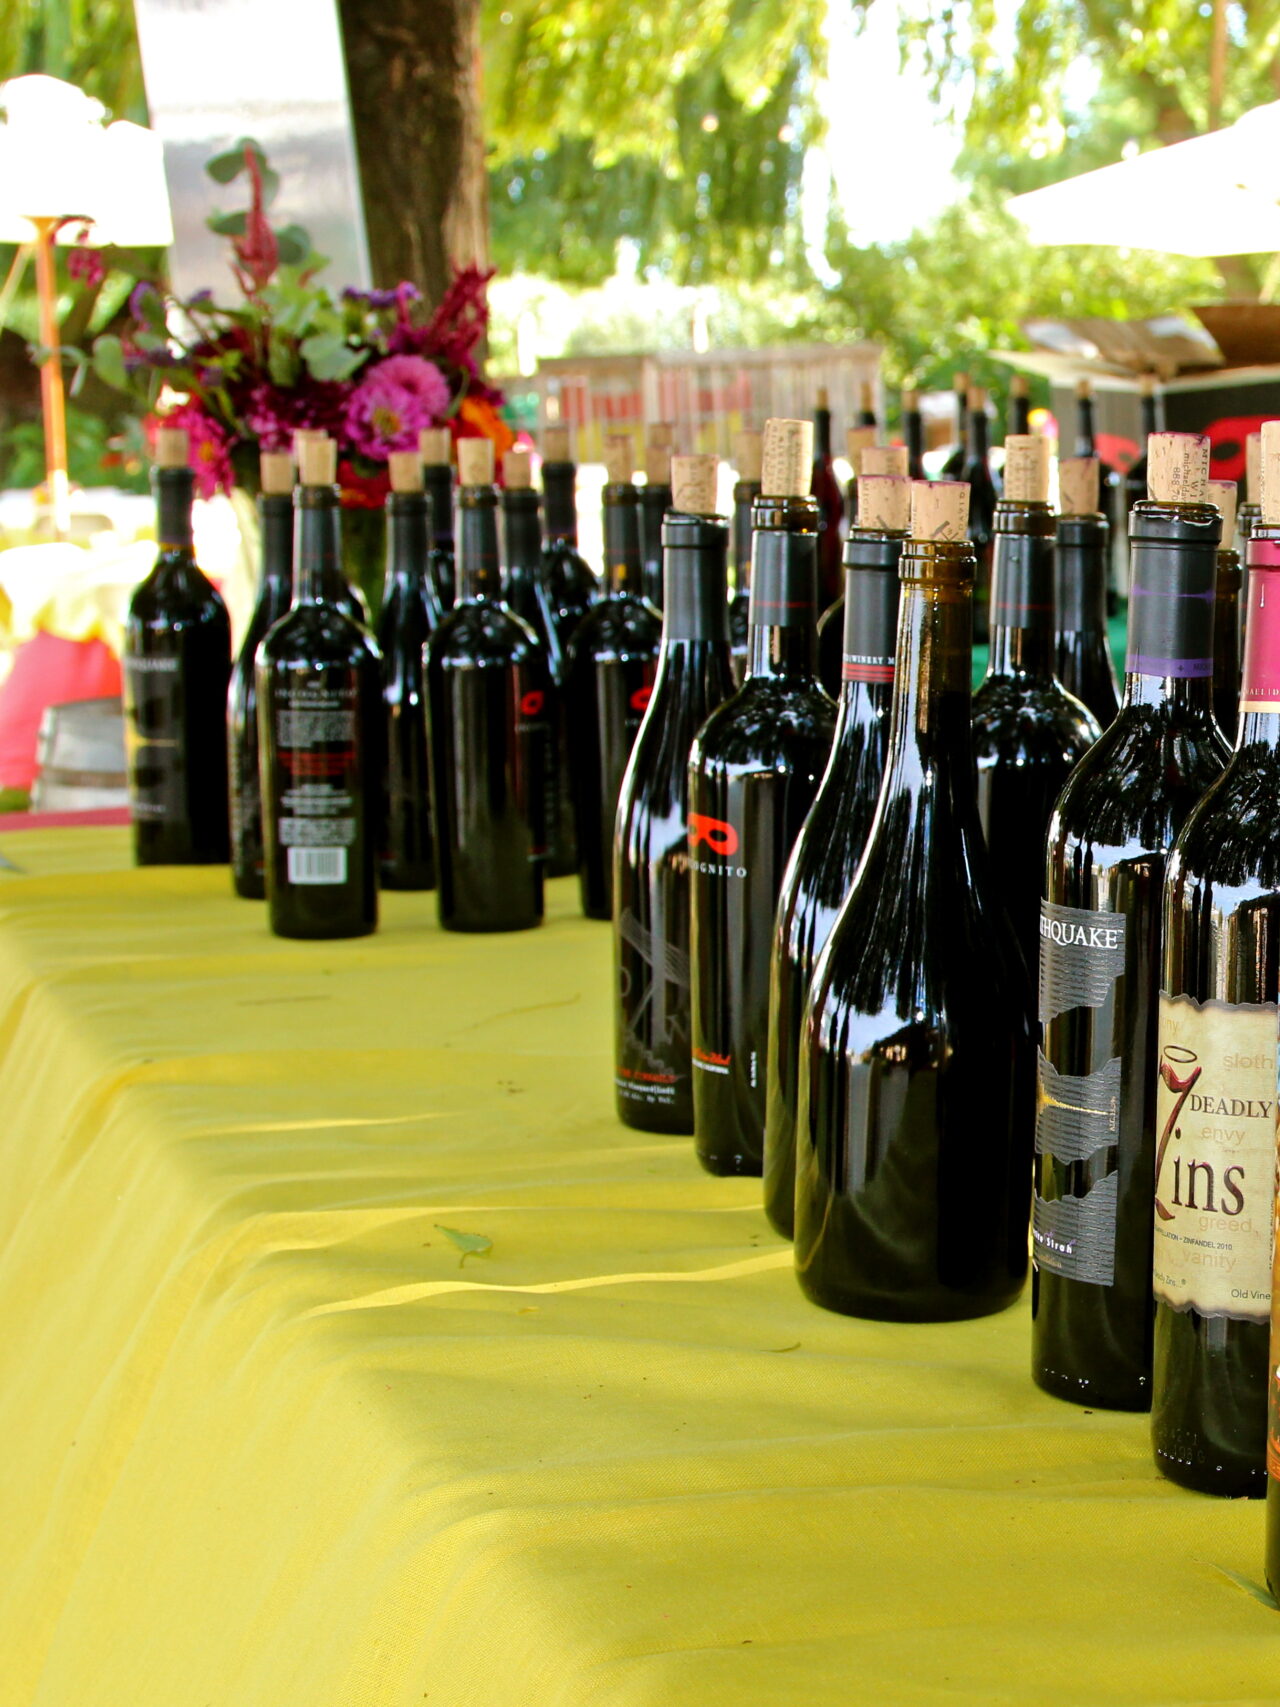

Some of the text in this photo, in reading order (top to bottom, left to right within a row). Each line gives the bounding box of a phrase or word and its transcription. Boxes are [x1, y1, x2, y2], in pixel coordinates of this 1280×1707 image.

[1223, 1052, 1274, 1070] sloth
[1190, 1093, 1273, 1119] DEADLY
[1200, 1127, 1246, 1146] envy
[1199, 1216, 1253, 1233] greed
[1183, 1236, 1233, 1251] ZINFANDEL 2010
[1183, 1248, 1238, 1272] vanity
[1231, 1288, 1271, 1300] Old Vine
